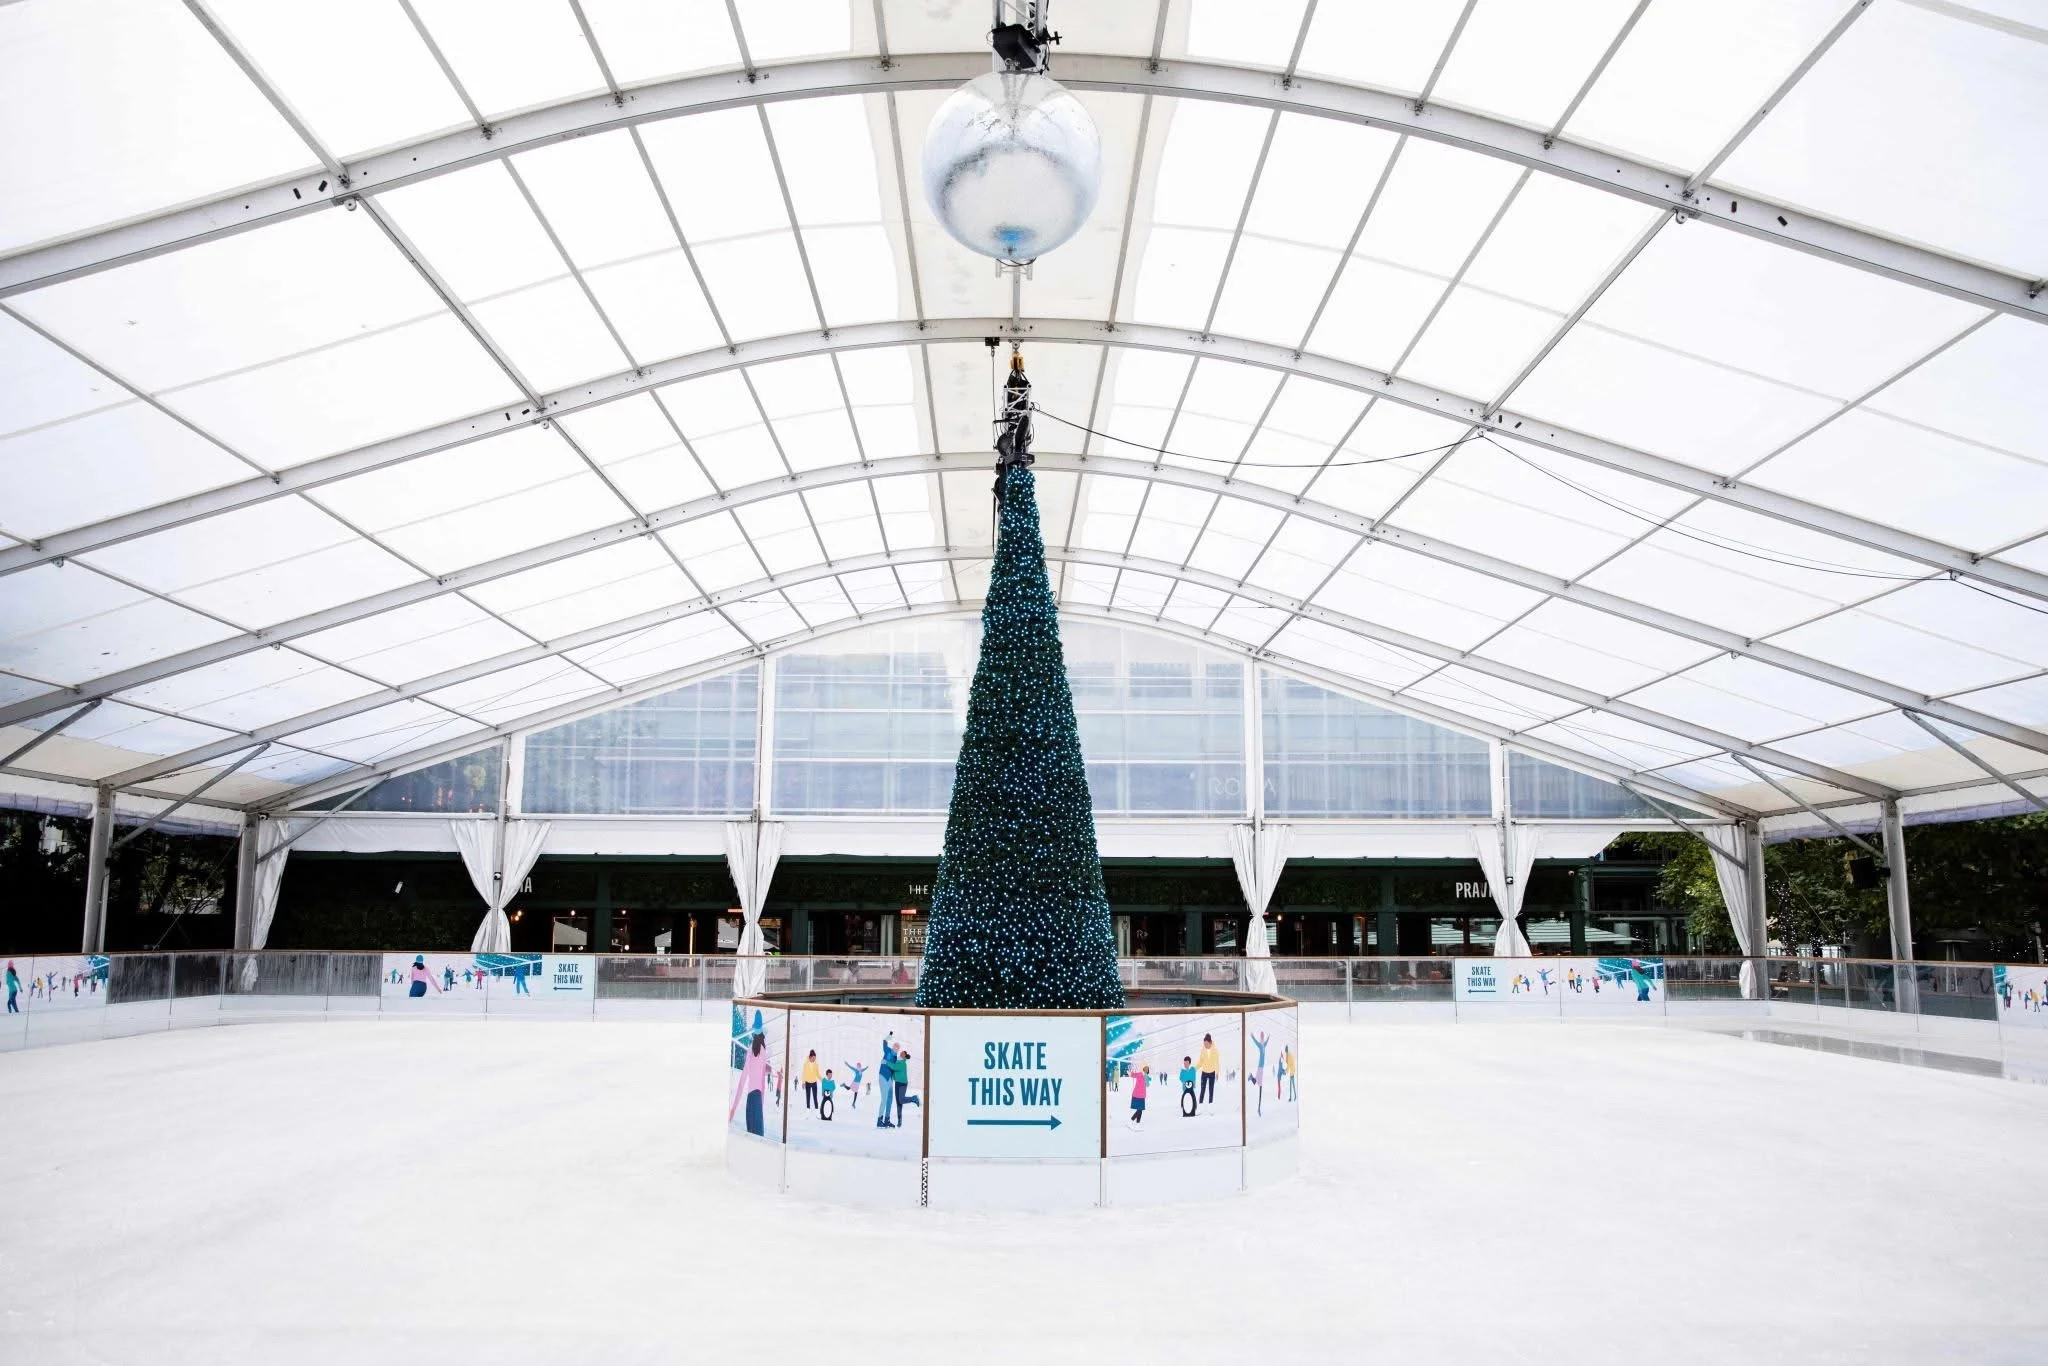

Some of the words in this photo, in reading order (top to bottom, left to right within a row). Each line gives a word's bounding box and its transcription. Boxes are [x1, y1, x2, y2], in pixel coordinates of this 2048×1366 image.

[909, 884, 929, 895] THE
[558, 963, 579, 973] SKATE
[1471, 966, 1492, 976] SKATE
[553, 974, 568, 984] THIS
[569, 974, 584, 984] WAY
[1467, 977, 1482, 987] THIS
[1482, 977, 1497, 987] WAY
[984, 1041, 1047, 1070] SKATE
[968, 1077, 1015, 1106] THIS
[1019, 1078, 1063, 1106] WAY
